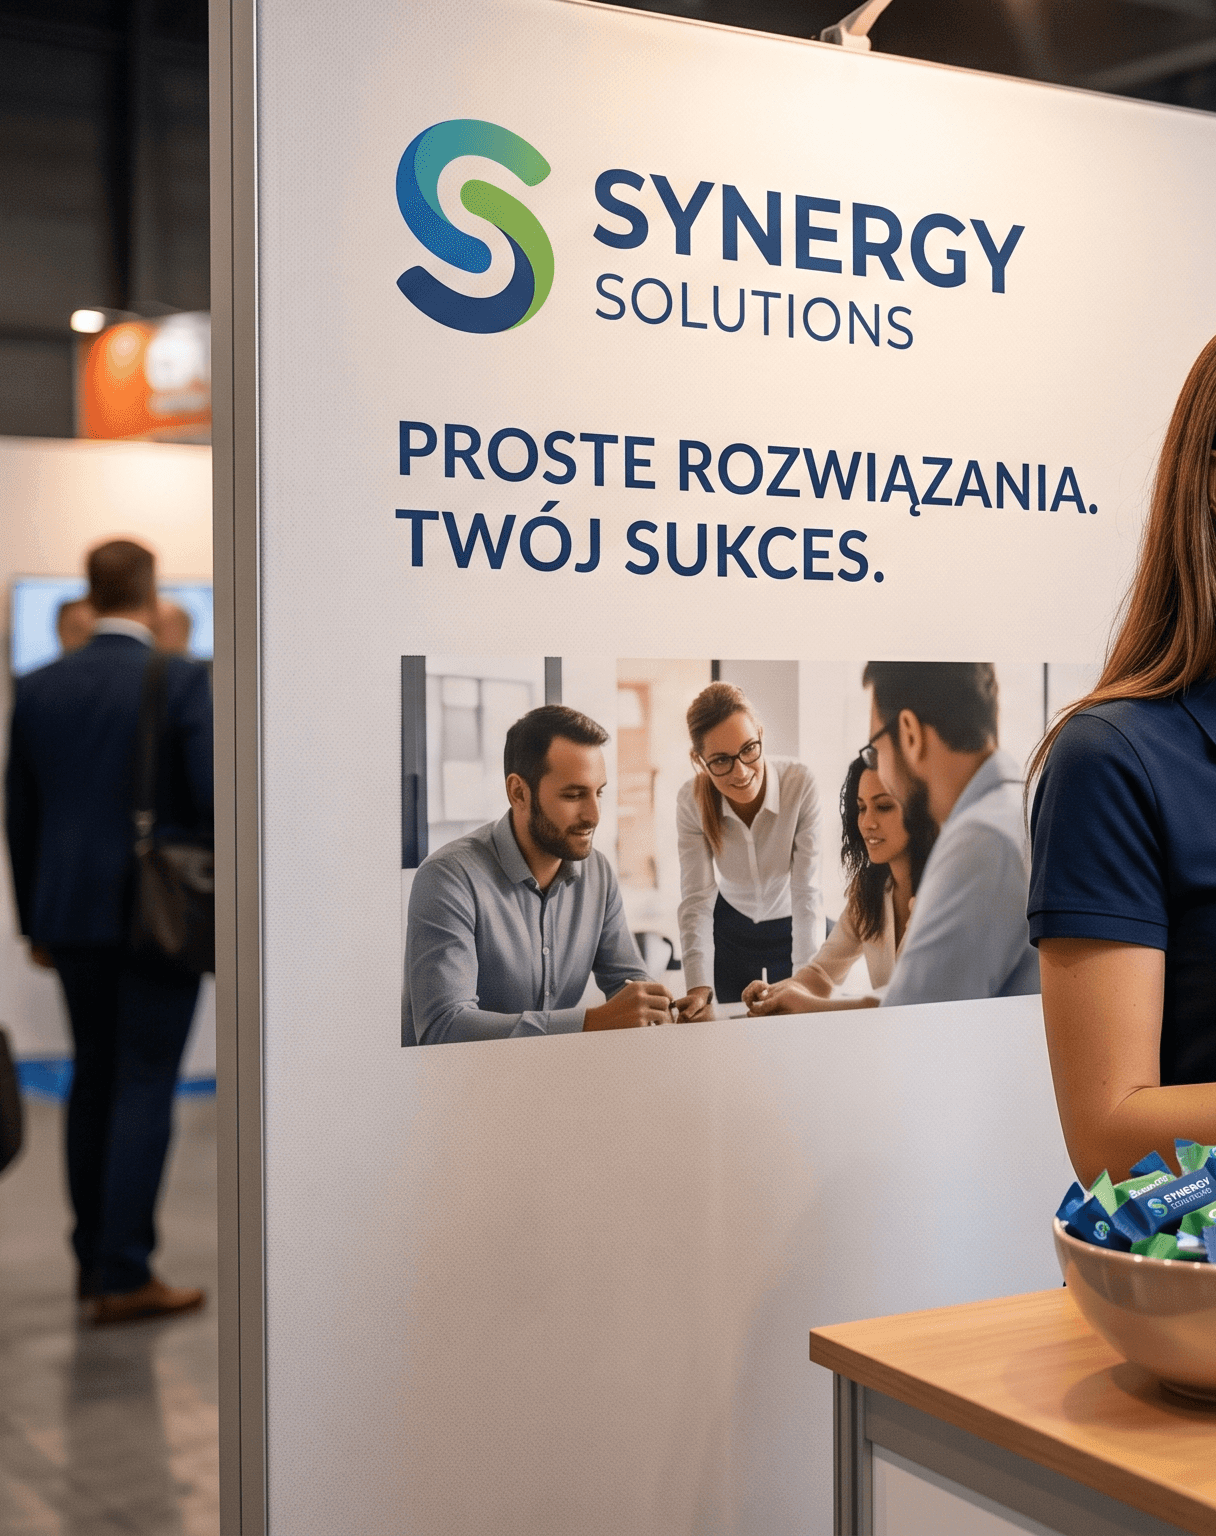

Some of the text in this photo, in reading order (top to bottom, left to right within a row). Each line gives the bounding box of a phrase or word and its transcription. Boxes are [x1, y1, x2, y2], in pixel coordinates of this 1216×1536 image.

[592, 168, 1026, 294] SYNERGY
[594, 272, 914, 350] SOLUTIONS
[399, 421, 1098, 516] PROSTE ROZWIĄZANIA.
[396, 501, 884, 583] TWÓJ SUKCES.
